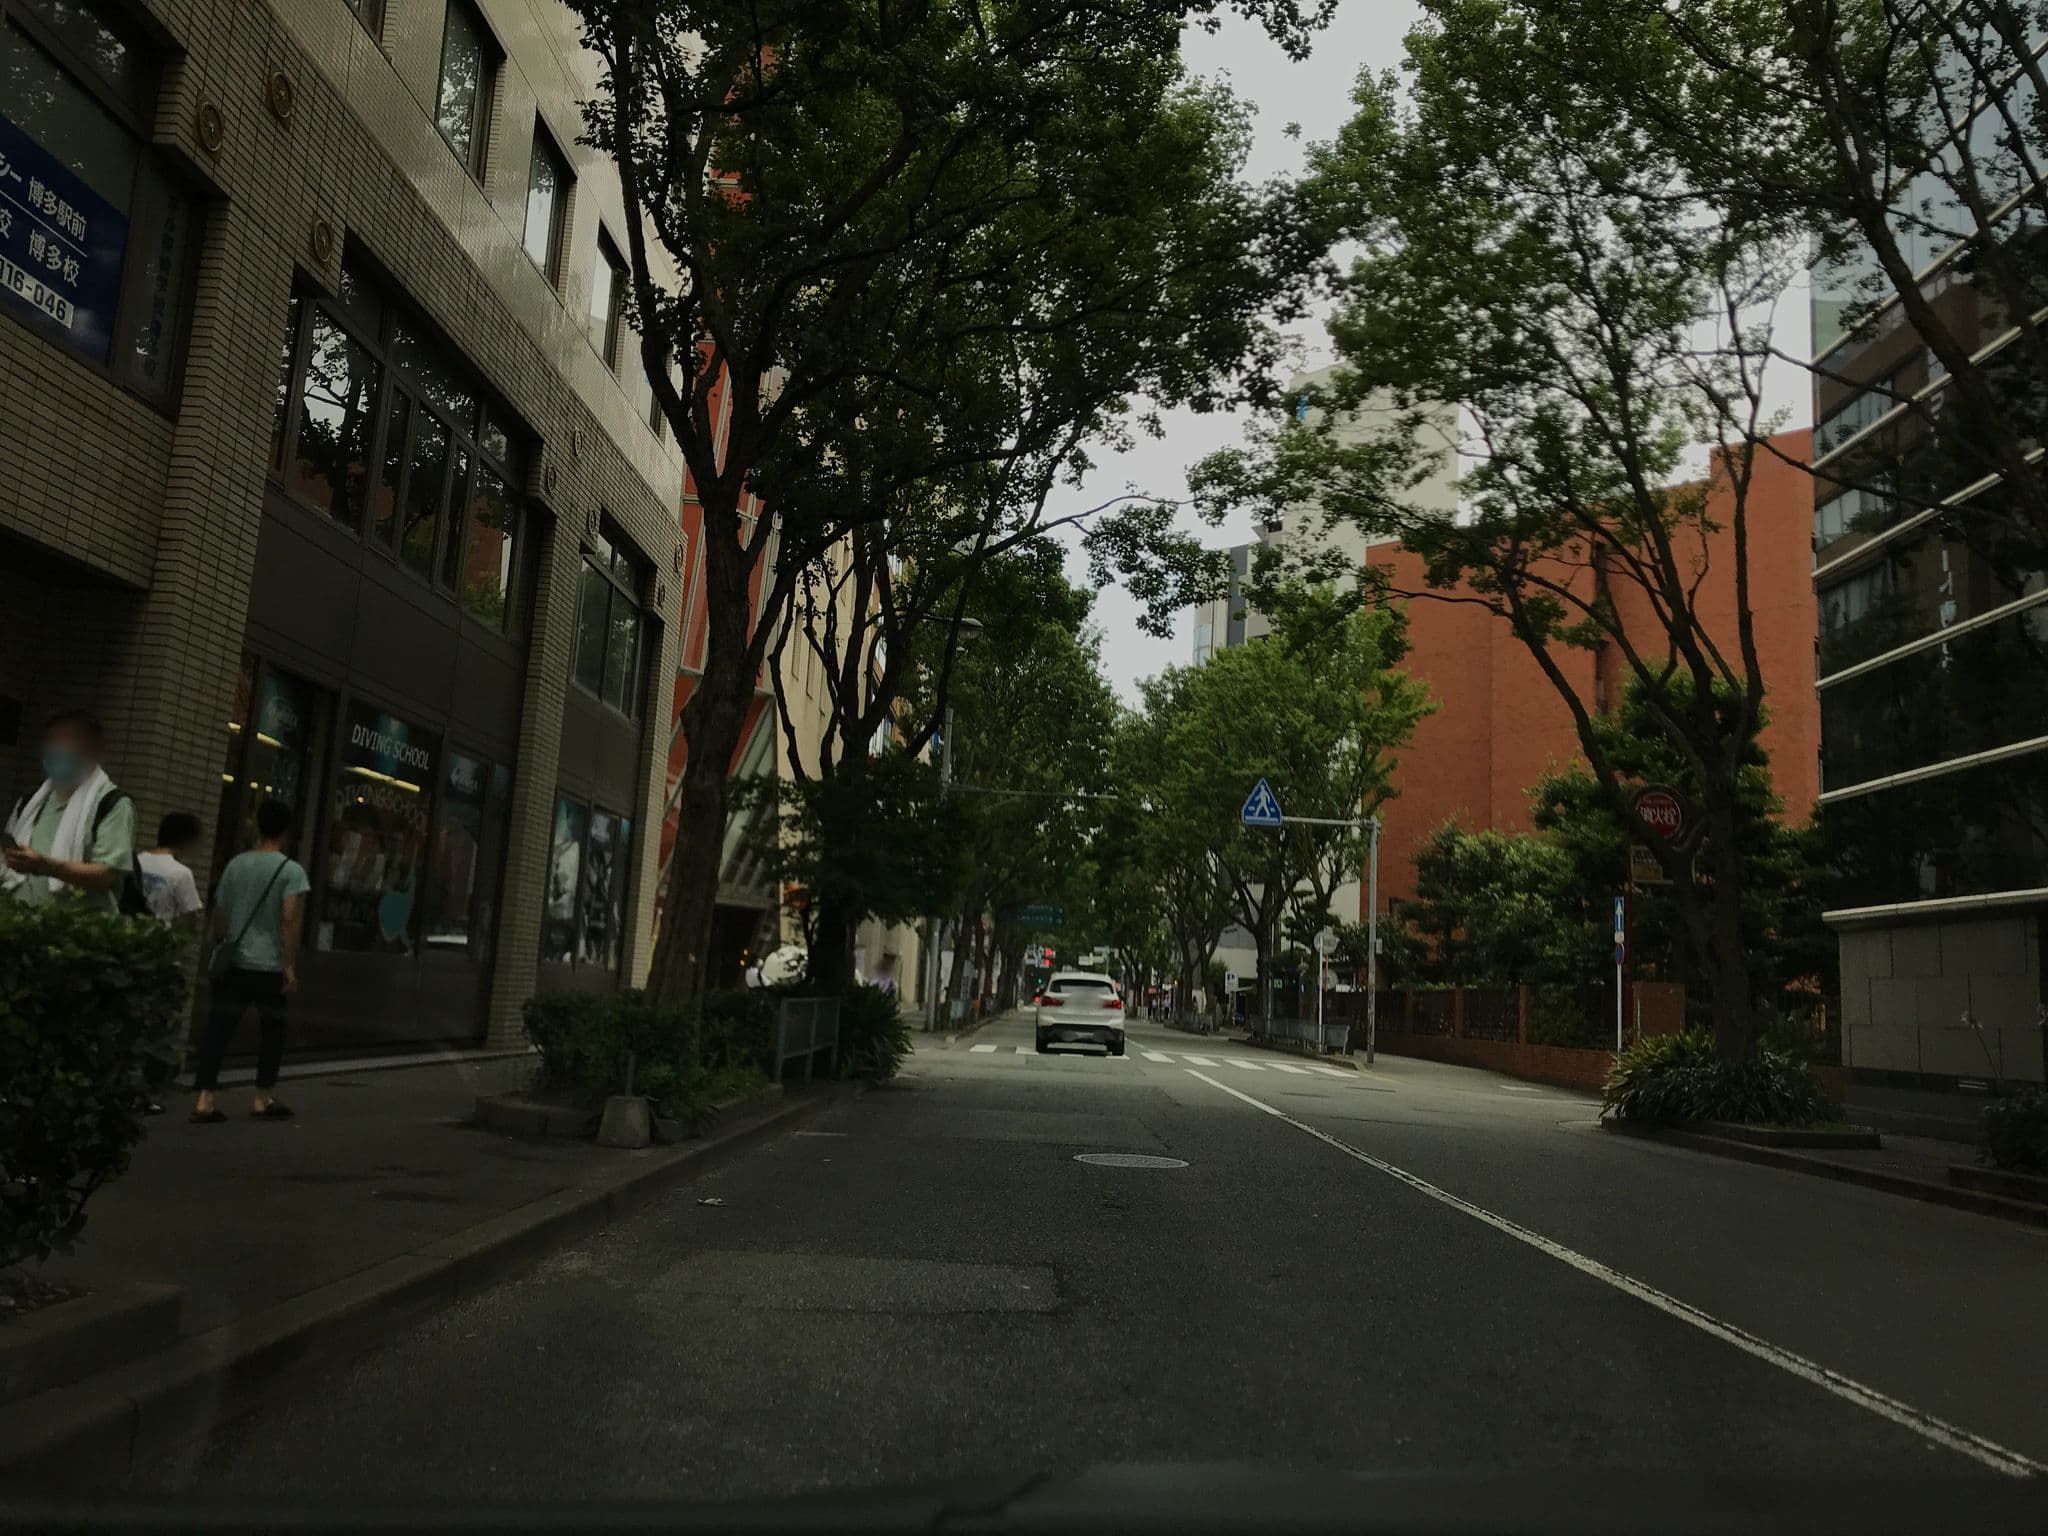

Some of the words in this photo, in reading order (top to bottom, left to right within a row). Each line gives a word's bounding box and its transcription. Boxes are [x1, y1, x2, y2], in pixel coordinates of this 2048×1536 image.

[28, 176, 87, 241] 博多駅前
[28, 229, 80, 287] 博多校
[352, 724, 392, 754] DIVING
[392, 741, 430, 770] SCHOOL
